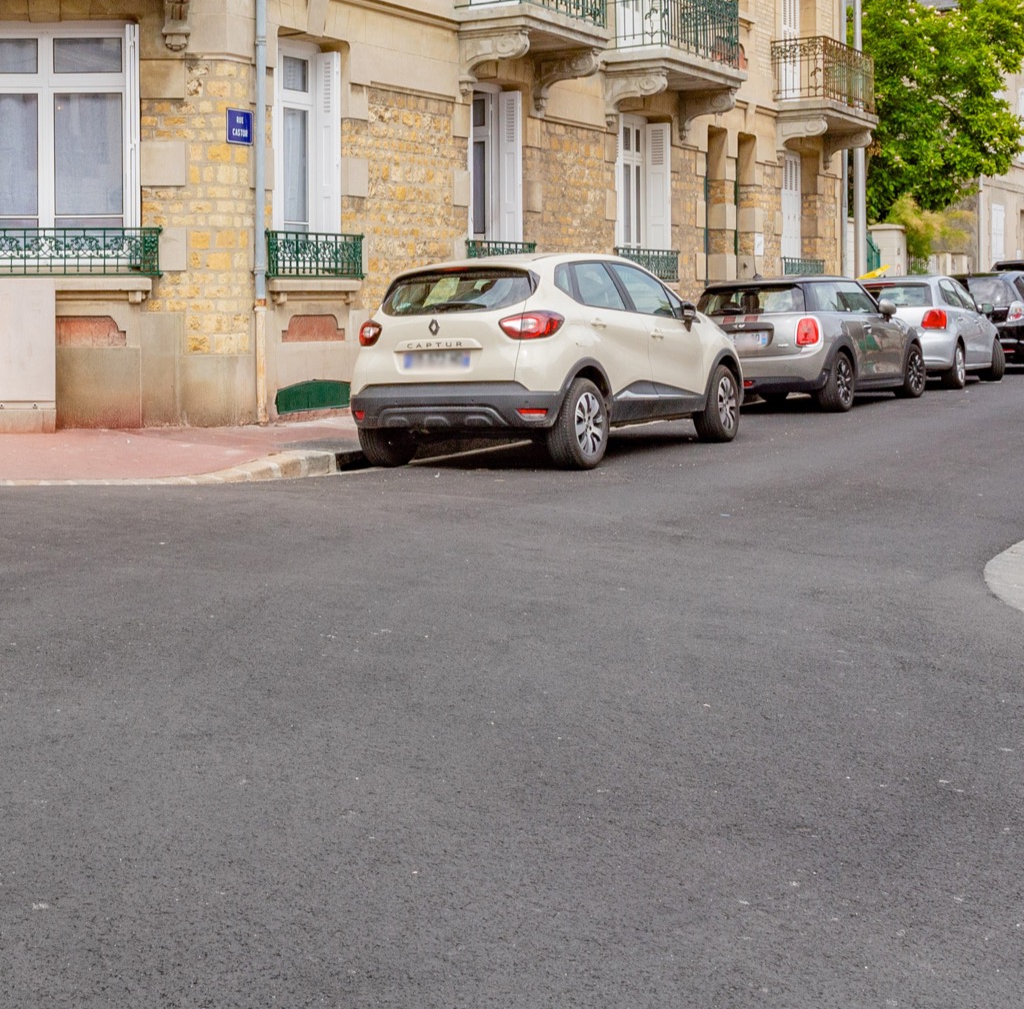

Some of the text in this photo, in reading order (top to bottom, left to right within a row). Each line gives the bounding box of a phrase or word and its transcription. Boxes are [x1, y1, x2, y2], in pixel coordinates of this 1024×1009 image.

[236, 116, 244, 124] RUE
[232, 128, 249, 138] CASTOR
[407, 341, 463, 349] CAPTUR
